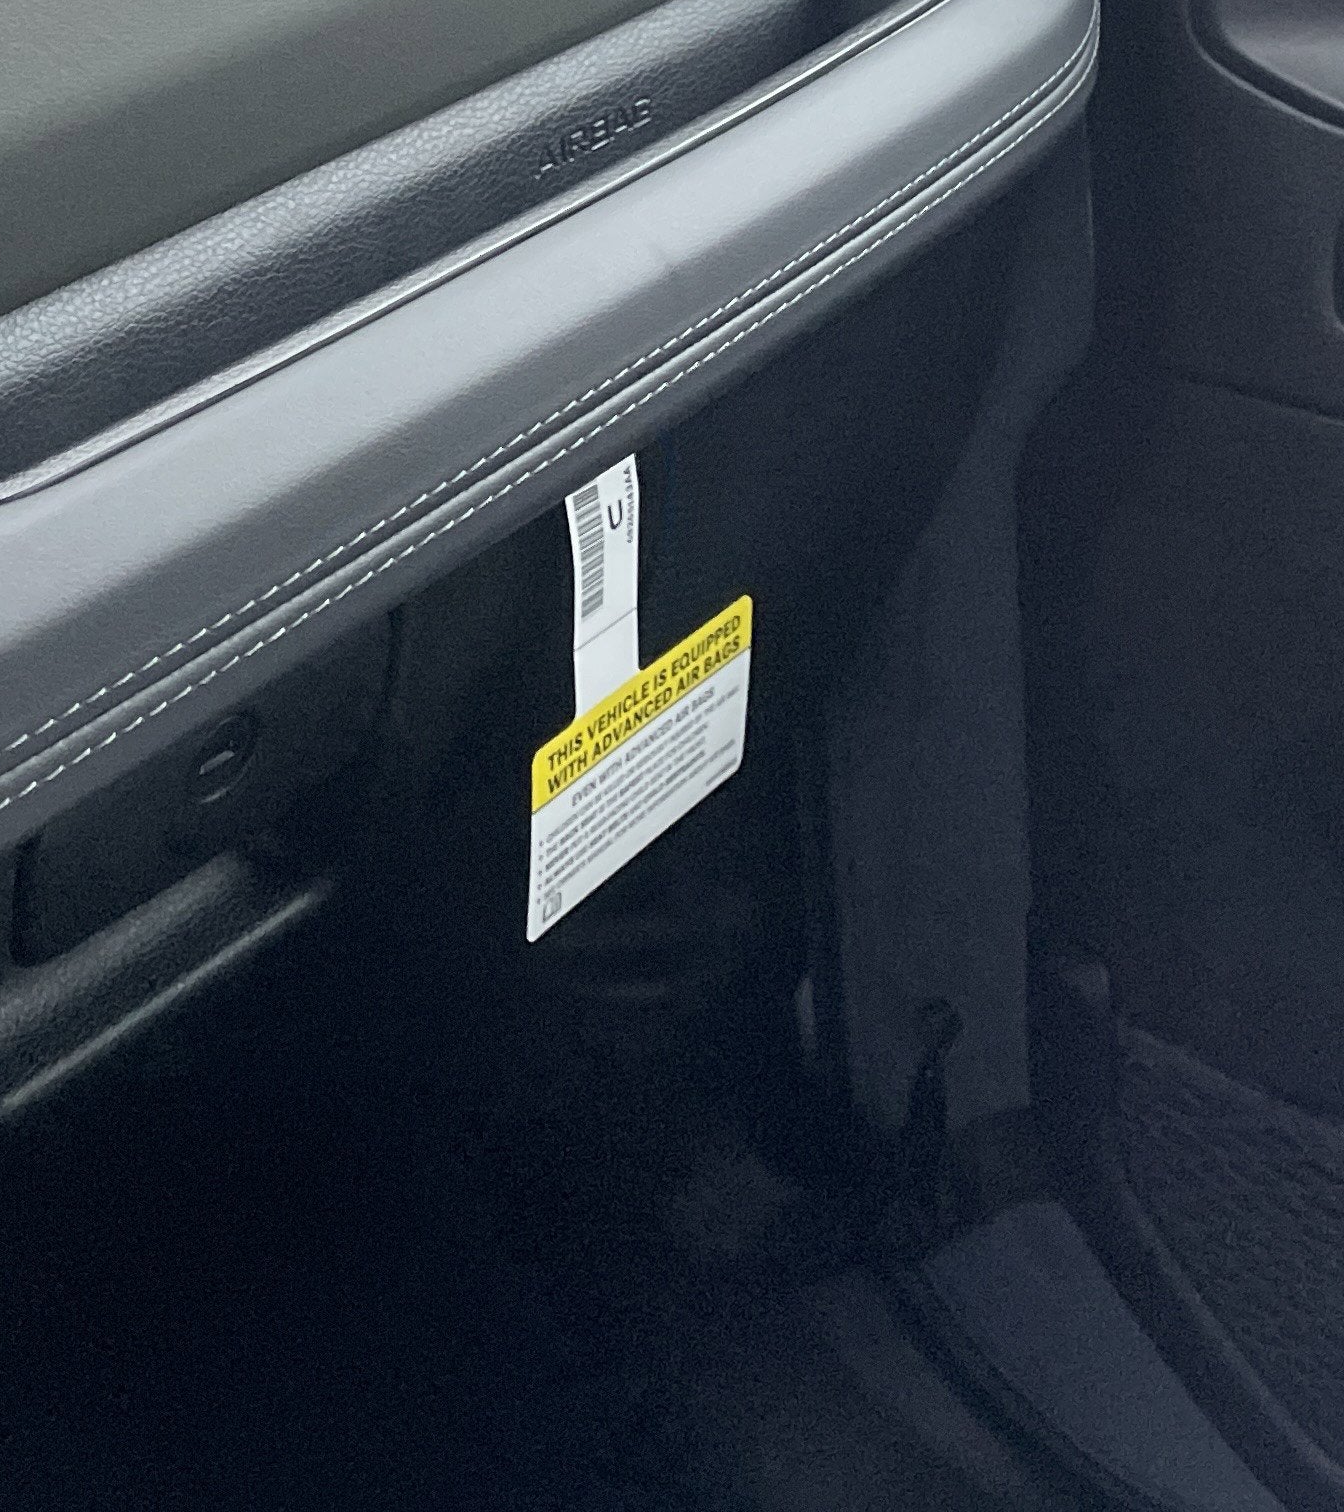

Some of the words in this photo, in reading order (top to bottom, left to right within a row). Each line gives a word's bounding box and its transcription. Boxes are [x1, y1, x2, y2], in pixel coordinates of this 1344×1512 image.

[547, 732, 583, 771] THIS
[586, 680, 650, 735] VEHICLE
[653, 668, 667, 689] IS
[671, 615, 741, 678] EQUIPPED
[547, 751, 589, 794] WITH
[591, 686, 673, 761] ADVANCED
[675, 665, 700, 696] AIR
[703, 635, 741, 675] BAGS
